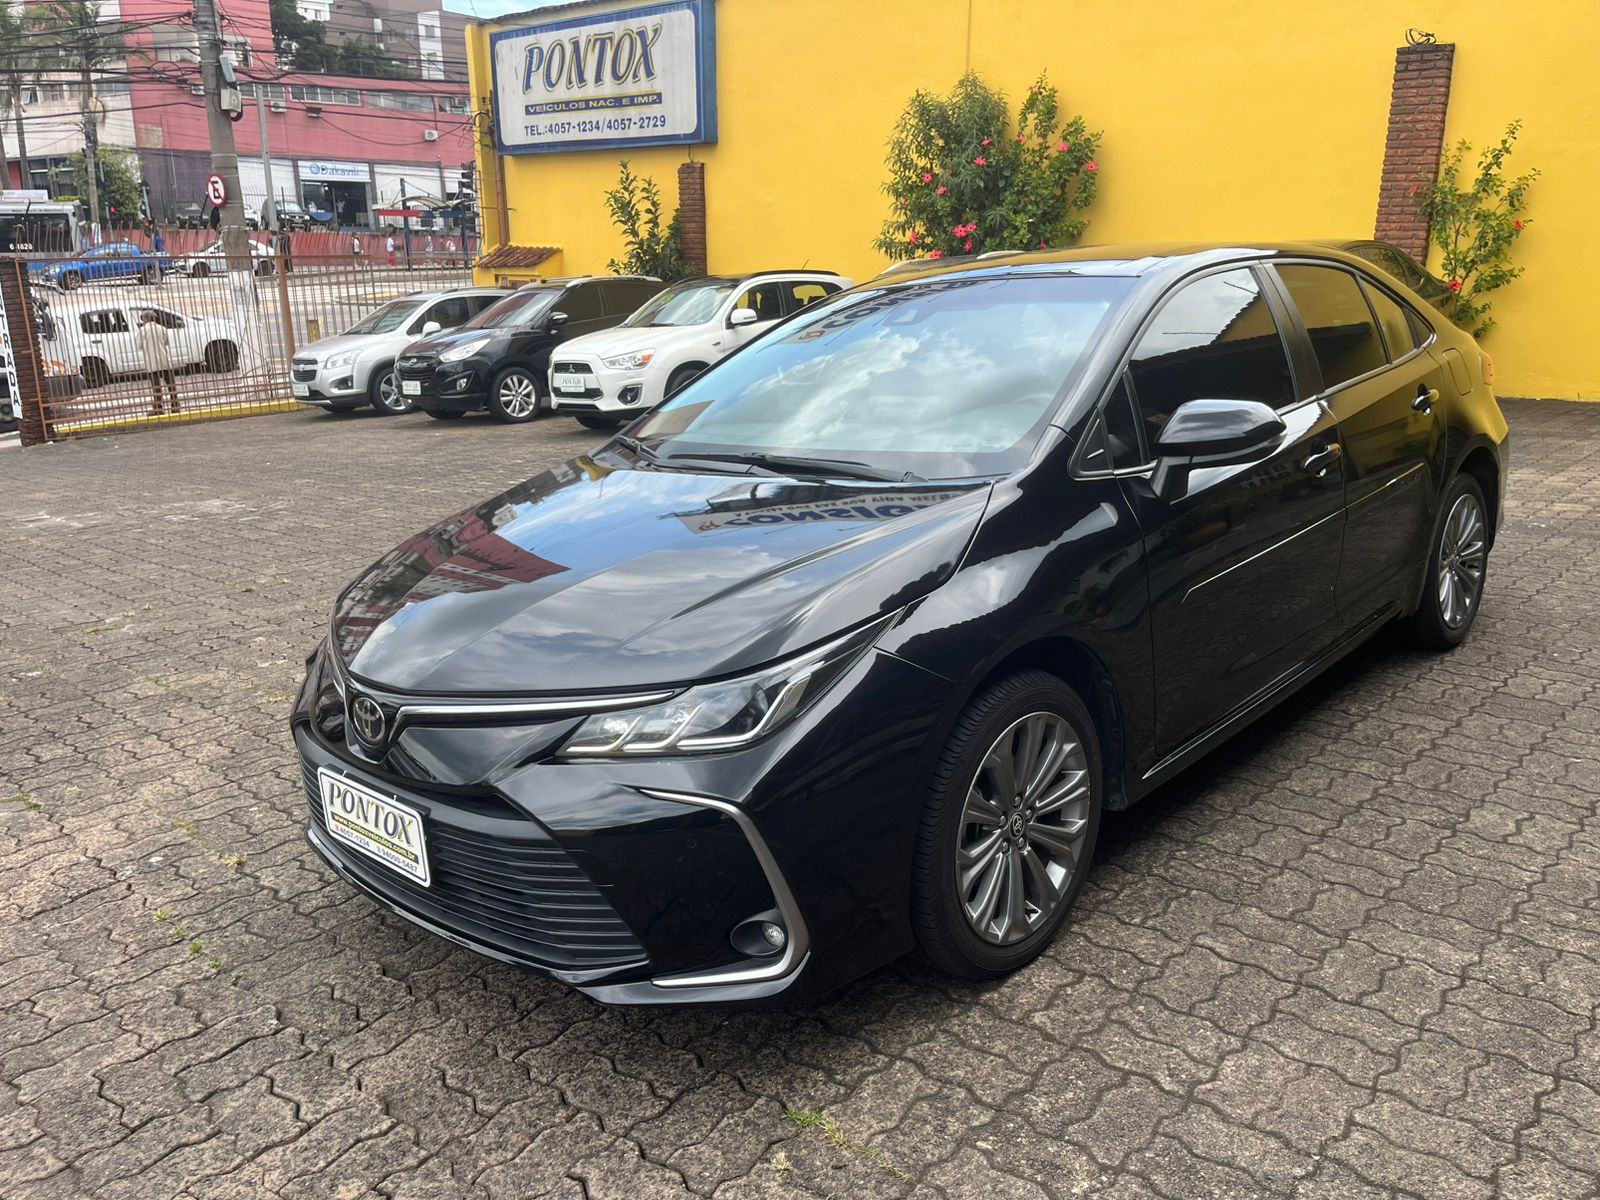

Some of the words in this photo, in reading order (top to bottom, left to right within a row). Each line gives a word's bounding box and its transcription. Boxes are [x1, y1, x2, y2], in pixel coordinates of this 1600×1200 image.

[522, 23, 662, 95] PONTOX
[589, 98, 618, 108] NAC.
[622, 97, 631, 106] E
[634, 94, 660, 105] IMP.
[328, 781, 414, 847] PONTOX
